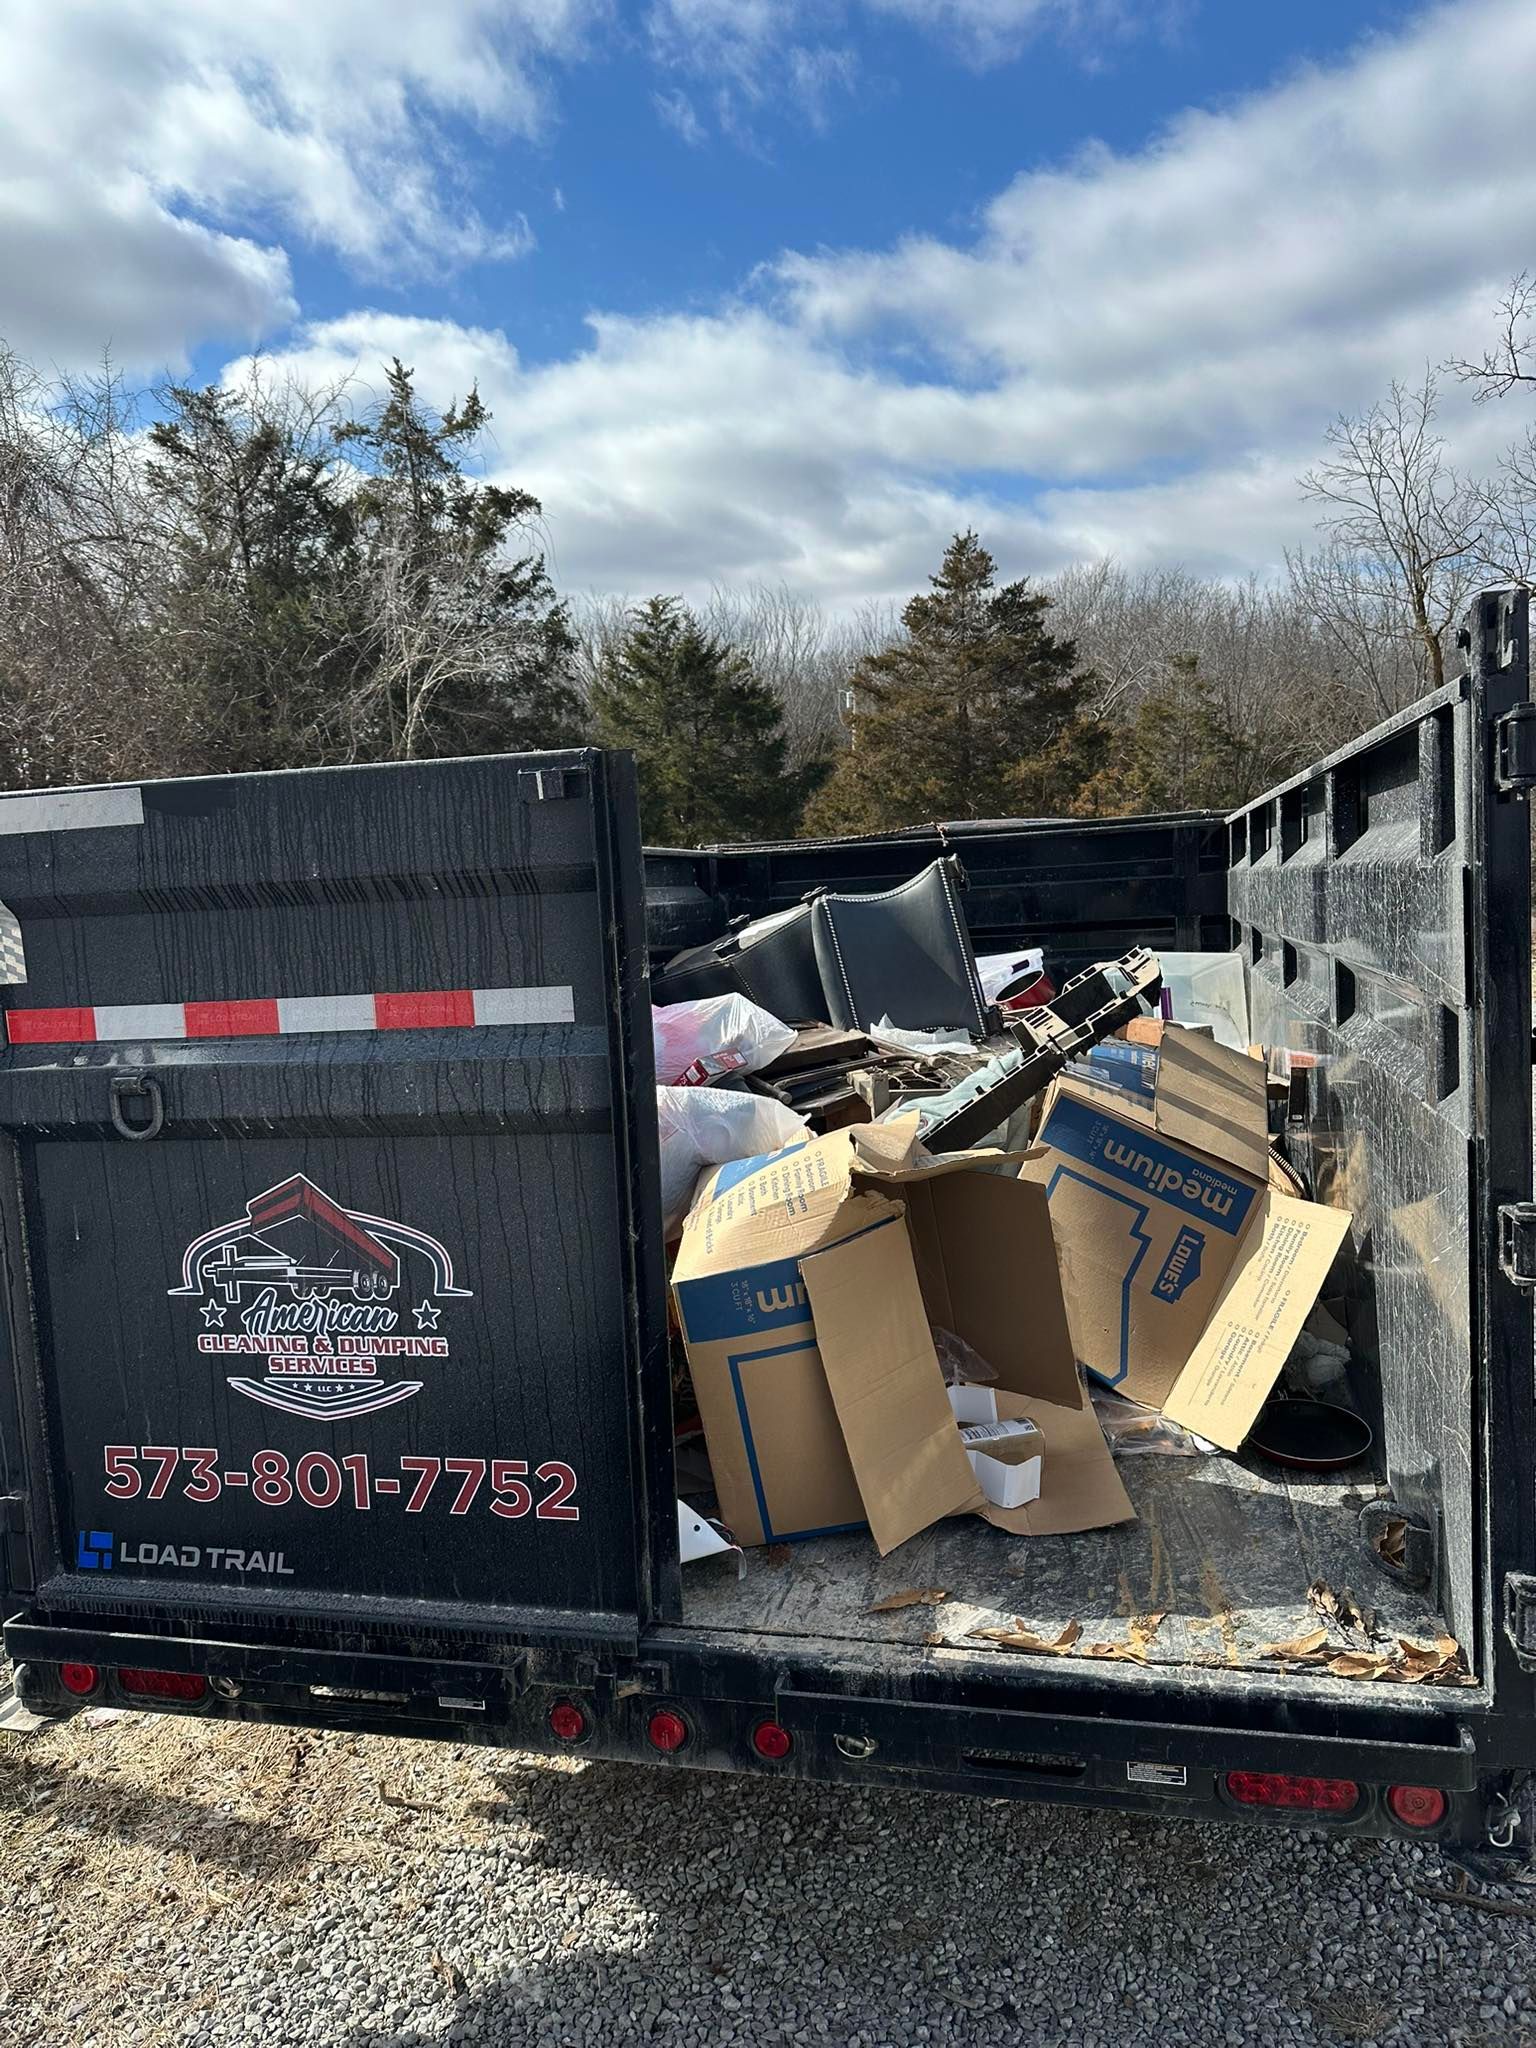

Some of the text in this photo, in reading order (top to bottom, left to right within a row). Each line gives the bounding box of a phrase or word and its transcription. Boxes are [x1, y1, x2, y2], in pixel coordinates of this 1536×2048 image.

[805, 1163, 816, 1192] Bedroom
[815, 1157, 829, 1186] FRAGILE
[1103, 1139, 1233, 1216] medium
[1191, 1167, 1238, 1195] mediana
[782, 1172, 795, 1216] Dining Room
[793, 1167, 808, 1212] Family Room
[1270, 1224, 1286, 1253] Kitchen
[1277, 1226, 1293, 1251] Dining
[1284, 1228, 1300, 1254] Family
[1288, 1230, 1307, 1265] Bedroom
[1158, 1234, 1199, 1294] LOWE'S
[1268, 1251, 1282, 1274] Room
[1275, 1254, 1288, 1277] Room
[240, 1288, 397, 1337] American
[1268, 1297, 1286, 1330] FRAGILE
[198, 1334, 449, 1357] CLEANING & DUMPING
[1218, 1330, 1236, 1360] Garage
[1224, 1333, 1243, 1365] Laundry
[1234, 1339, 1256, 1378] Basement
[1237, 1336, 1250, 1355] Attic
[269, 1355, 377, 1375] SERVICES
[104, 1445, 580, 1522] 573-801-7752
[120, 1542, 294, 1576] LOAD TRAIL
